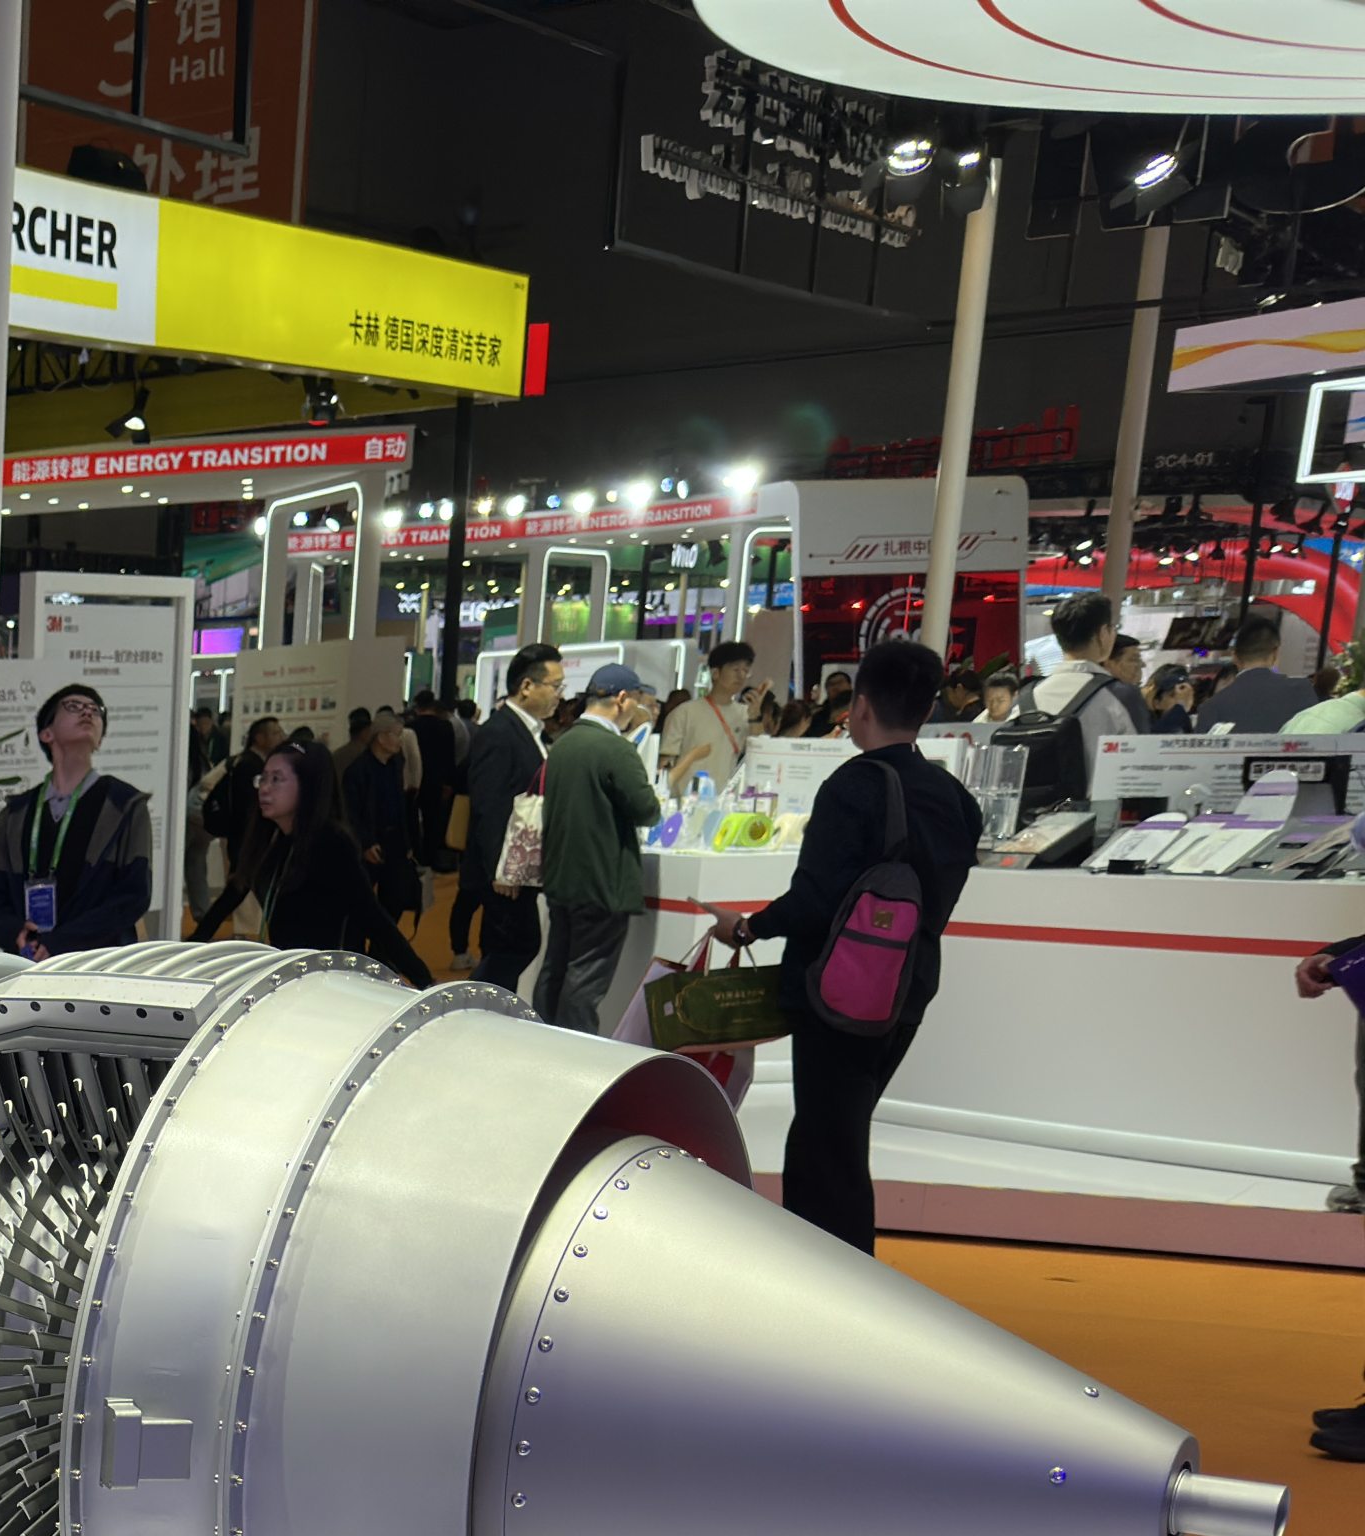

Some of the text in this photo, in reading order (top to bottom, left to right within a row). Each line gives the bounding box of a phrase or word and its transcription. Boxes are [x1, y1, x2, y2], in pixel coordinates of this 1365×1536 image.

[169, 46, 226, 85] Hall
[349, 309, 502, 368] 卡赫 德国深度清洁专家
[12, 436, 407, 484] 能源转型 ENERGY TRANSITION 自动
[409, 524, 502, 544] TRANTION
